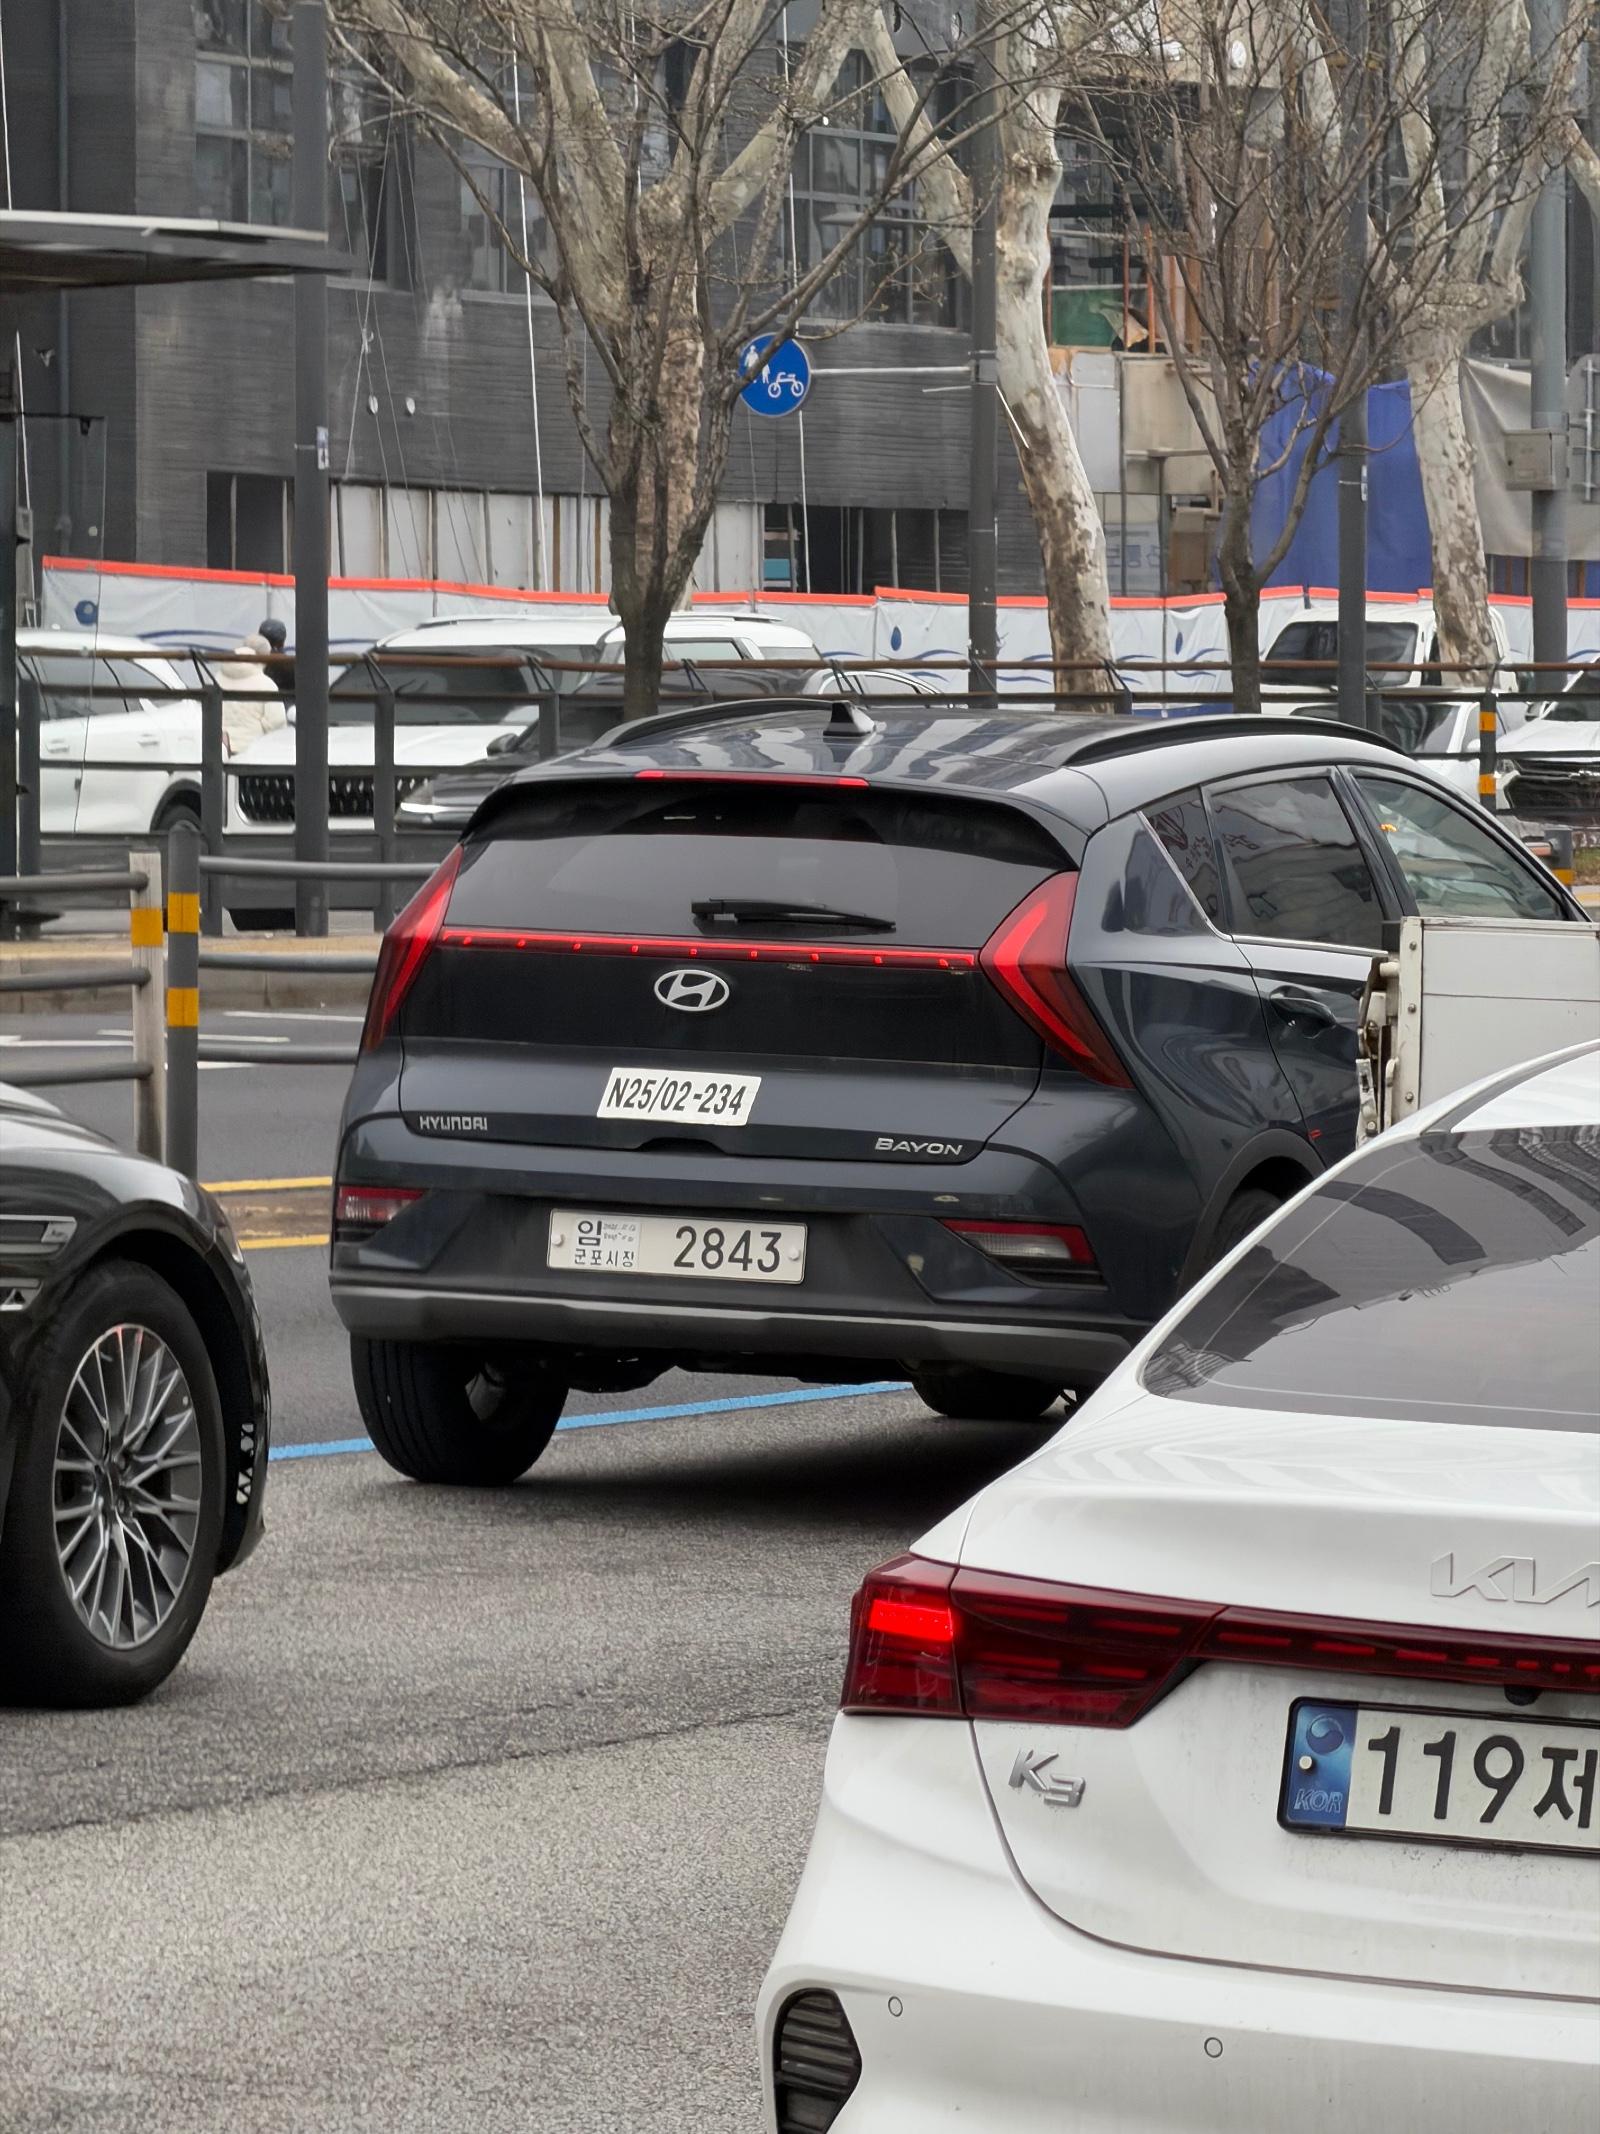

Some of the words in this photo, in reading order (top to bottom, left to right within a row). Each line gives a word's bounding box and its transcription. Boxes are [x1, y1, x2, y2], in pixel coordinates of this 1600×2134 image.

[606, 1077, 747, 1116] N25/02-234
[419, 1116, 488, 1131] HYUNDAI
[875, 1137, 964, 1156] BAYON
[578, 1220, 602, 1246] 임
[574, 1248, 635, 1268] 군포시장
[673, 1225, 782, 1273] 2843
[1008, 1747, 1086, 1808] K3
[1368, 1726, 1598, 1829] 119저
[1293, 1787, 1342, 1814] KOR
